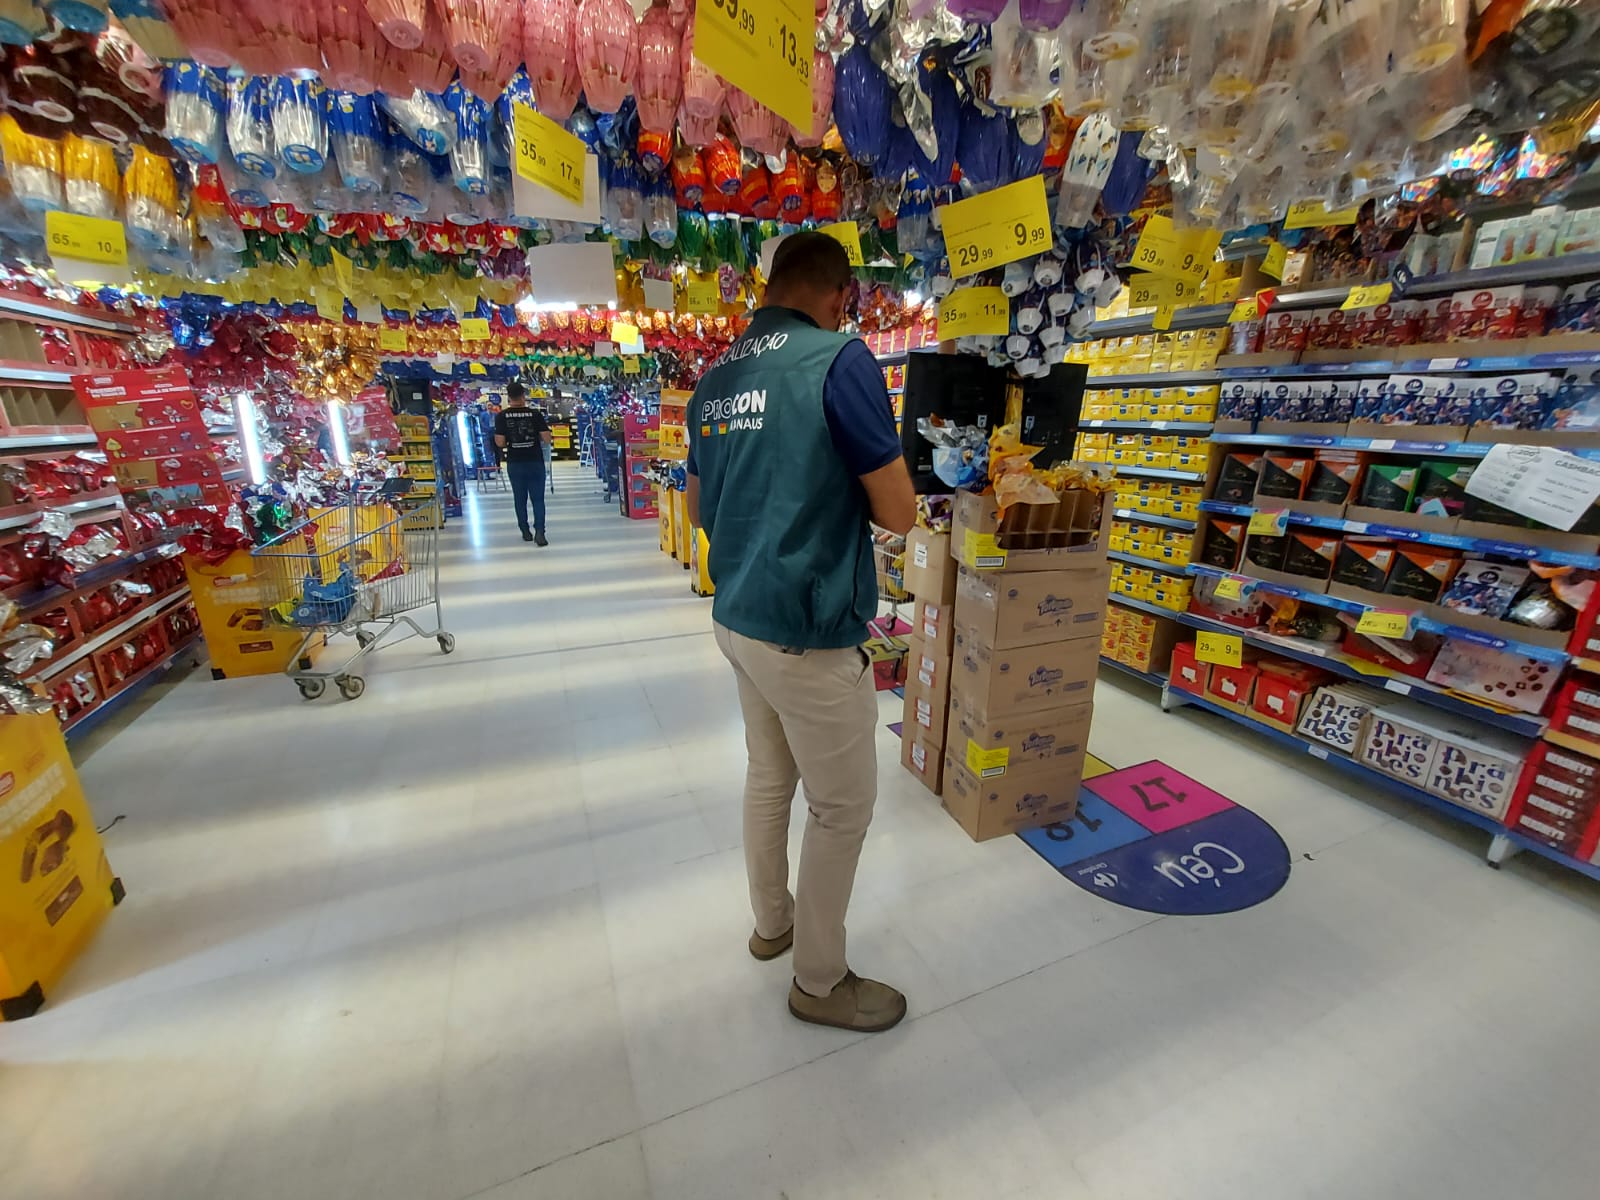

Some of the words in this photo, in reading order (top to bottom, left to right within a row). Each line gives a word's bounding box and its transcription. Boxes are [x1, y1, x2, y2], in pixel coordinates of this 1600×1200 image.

[713, 0, 755, 36] 9,99
[1014, 222, 1045, 247] 9,99
[958, 244, 994, 267] 29,99
[702, 389, 767, 422] PROCON
[1129, 776, 1188, 812] 17
[1153, 841, 1246, 888] Céu
